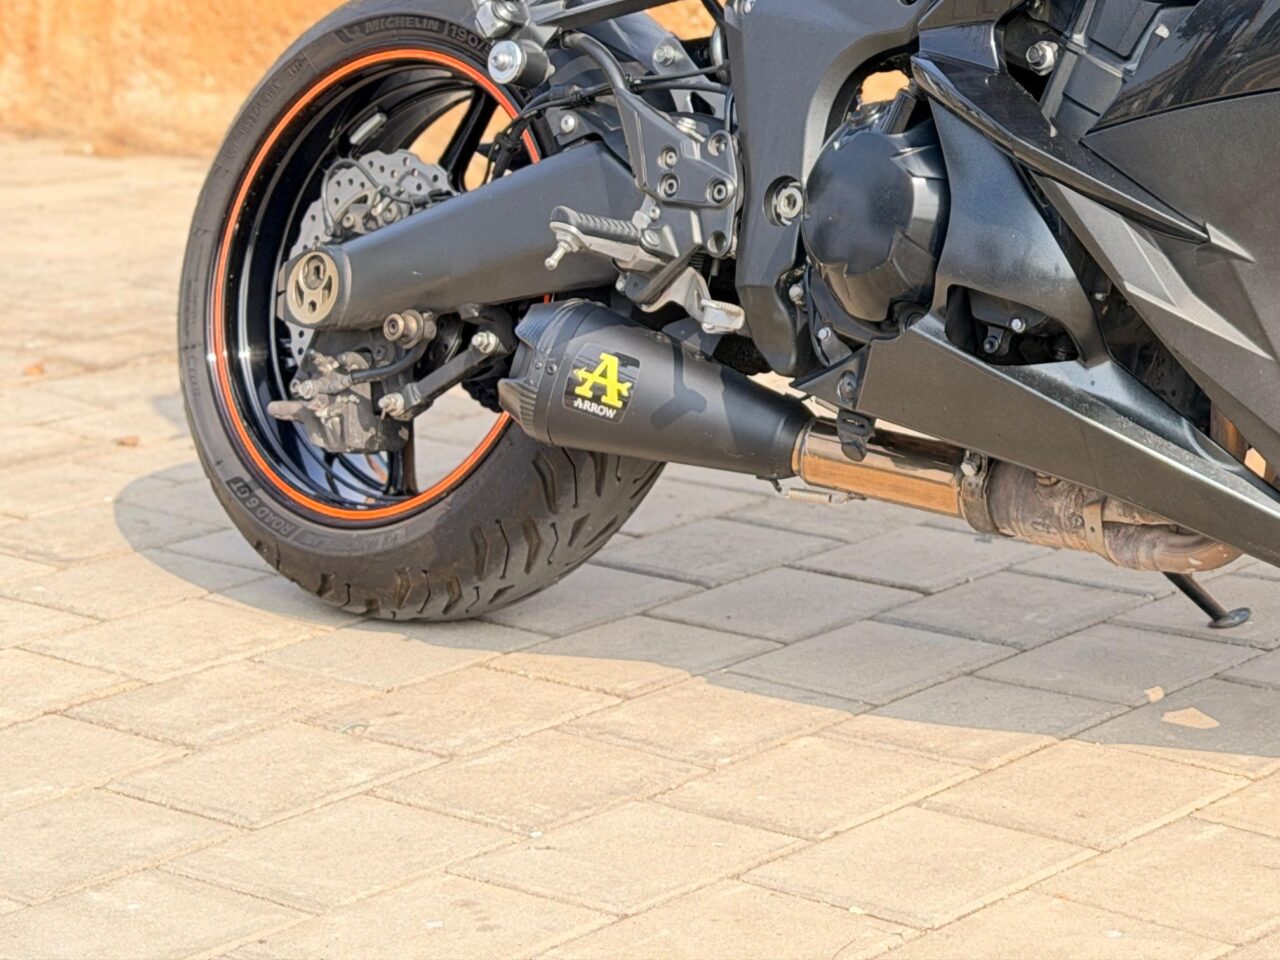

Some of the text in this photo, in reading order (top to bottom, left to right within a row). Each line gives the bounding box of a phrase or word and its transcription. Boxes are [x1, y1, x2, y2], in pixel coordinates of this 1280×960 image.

[365, 16, 440, 34] MICHELIN
[573, 398, 617, 420] ARROW
[230, 481, 295, 535] ROAD 6 GT
